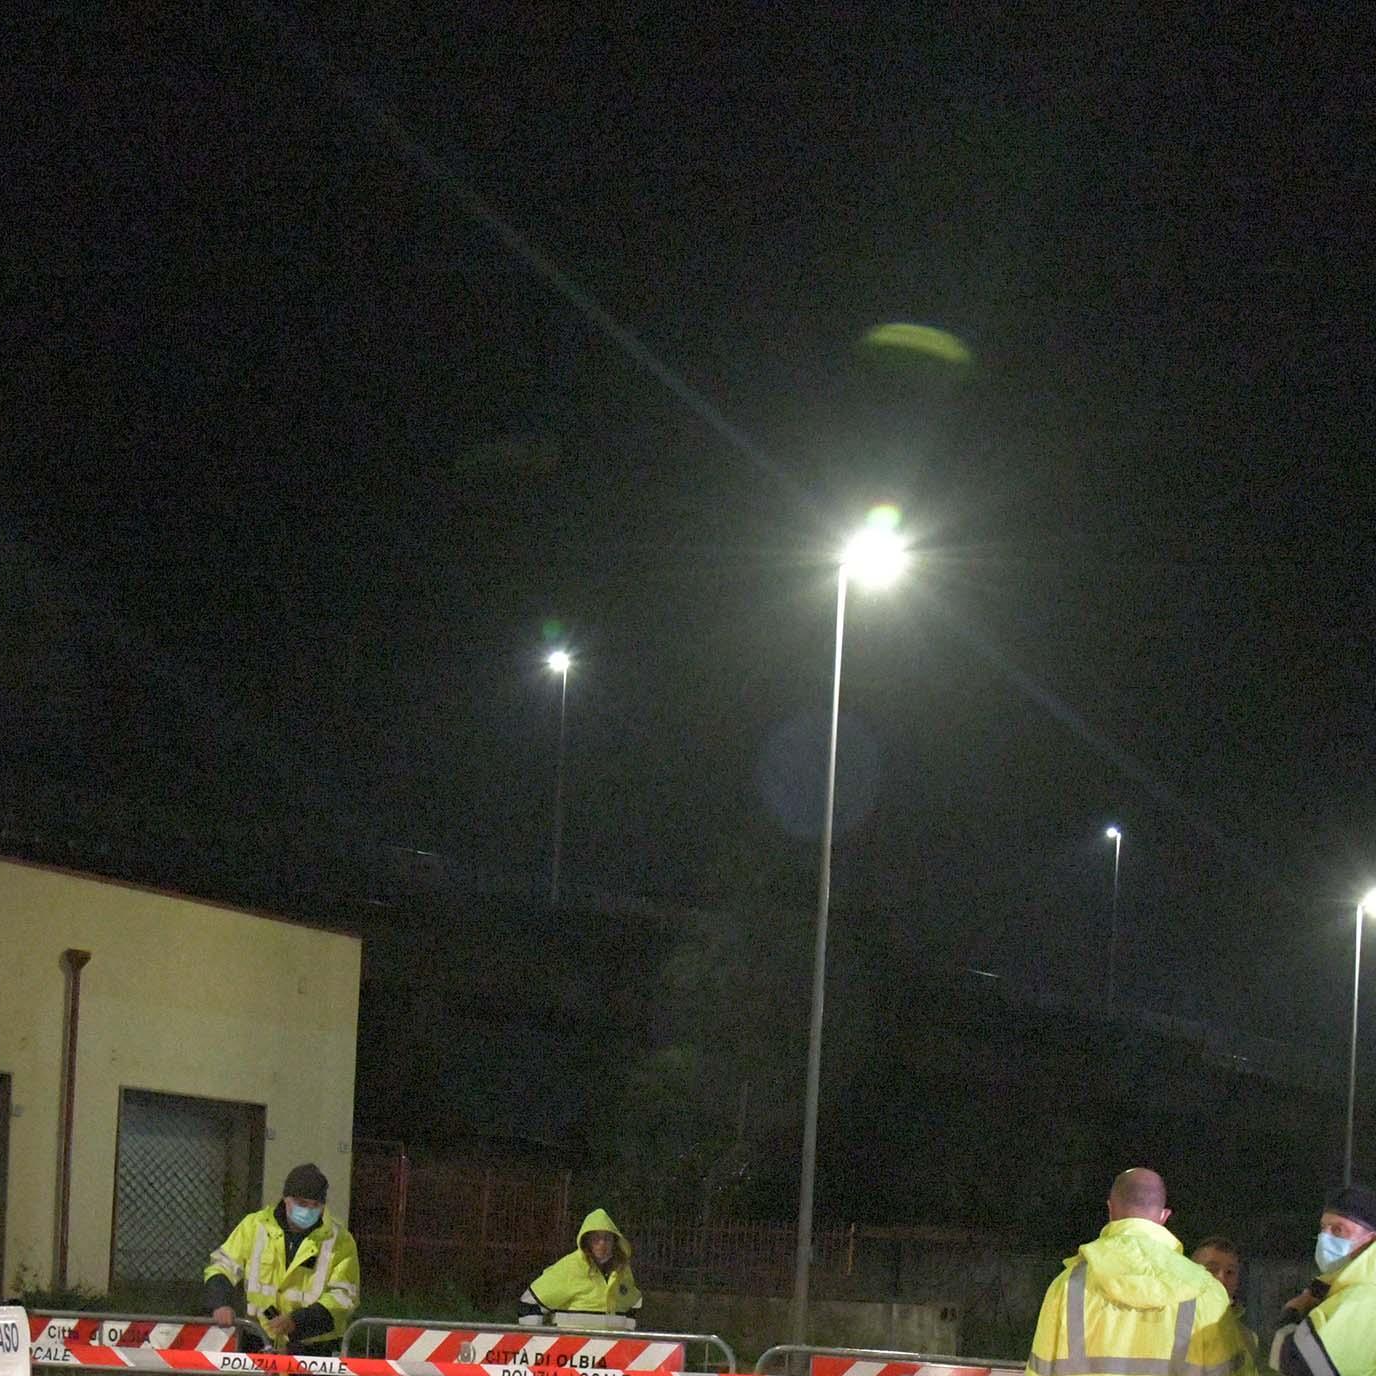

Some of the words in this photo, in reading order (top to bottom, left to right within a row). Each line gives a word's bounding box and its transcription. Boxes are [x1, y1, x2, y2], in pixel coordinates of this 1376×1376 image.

[29, 1346, 71, 1361] CALE
[485, 1348, 529, 1365] CITTÀ
[534, 1353, 550, 1366] DI
[556, 1354, 607, 1369] OLBIA
[221, 1357, 277, 1371] POLIZIA
[288, 1360, 348, 1374] LOCALE
